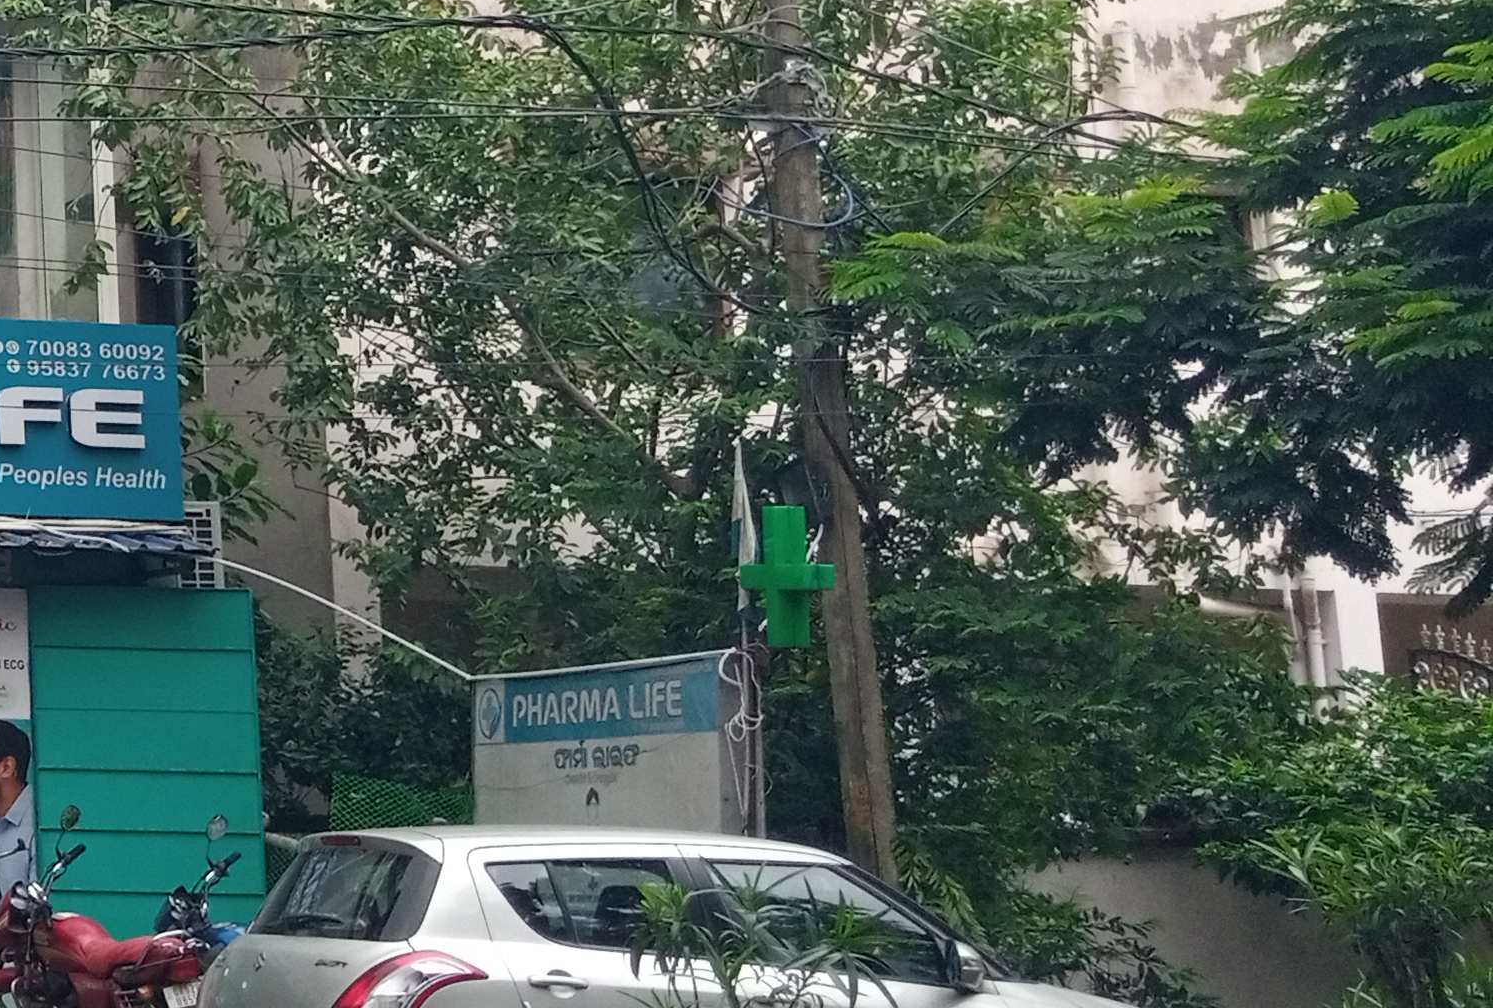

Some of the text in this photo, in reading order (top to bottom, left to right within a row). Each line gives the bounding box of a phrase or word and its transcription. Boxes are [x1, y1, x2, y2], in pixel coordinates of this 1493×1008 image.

[25, 339, 165, 362] 70083 60092
[26, 359, 167, 381] 95837 76673
[95, 467, 167, 490] Health
[3, 659, 25, 671] ECG
[511, 678, 683, 728] PHARMA LIFE
